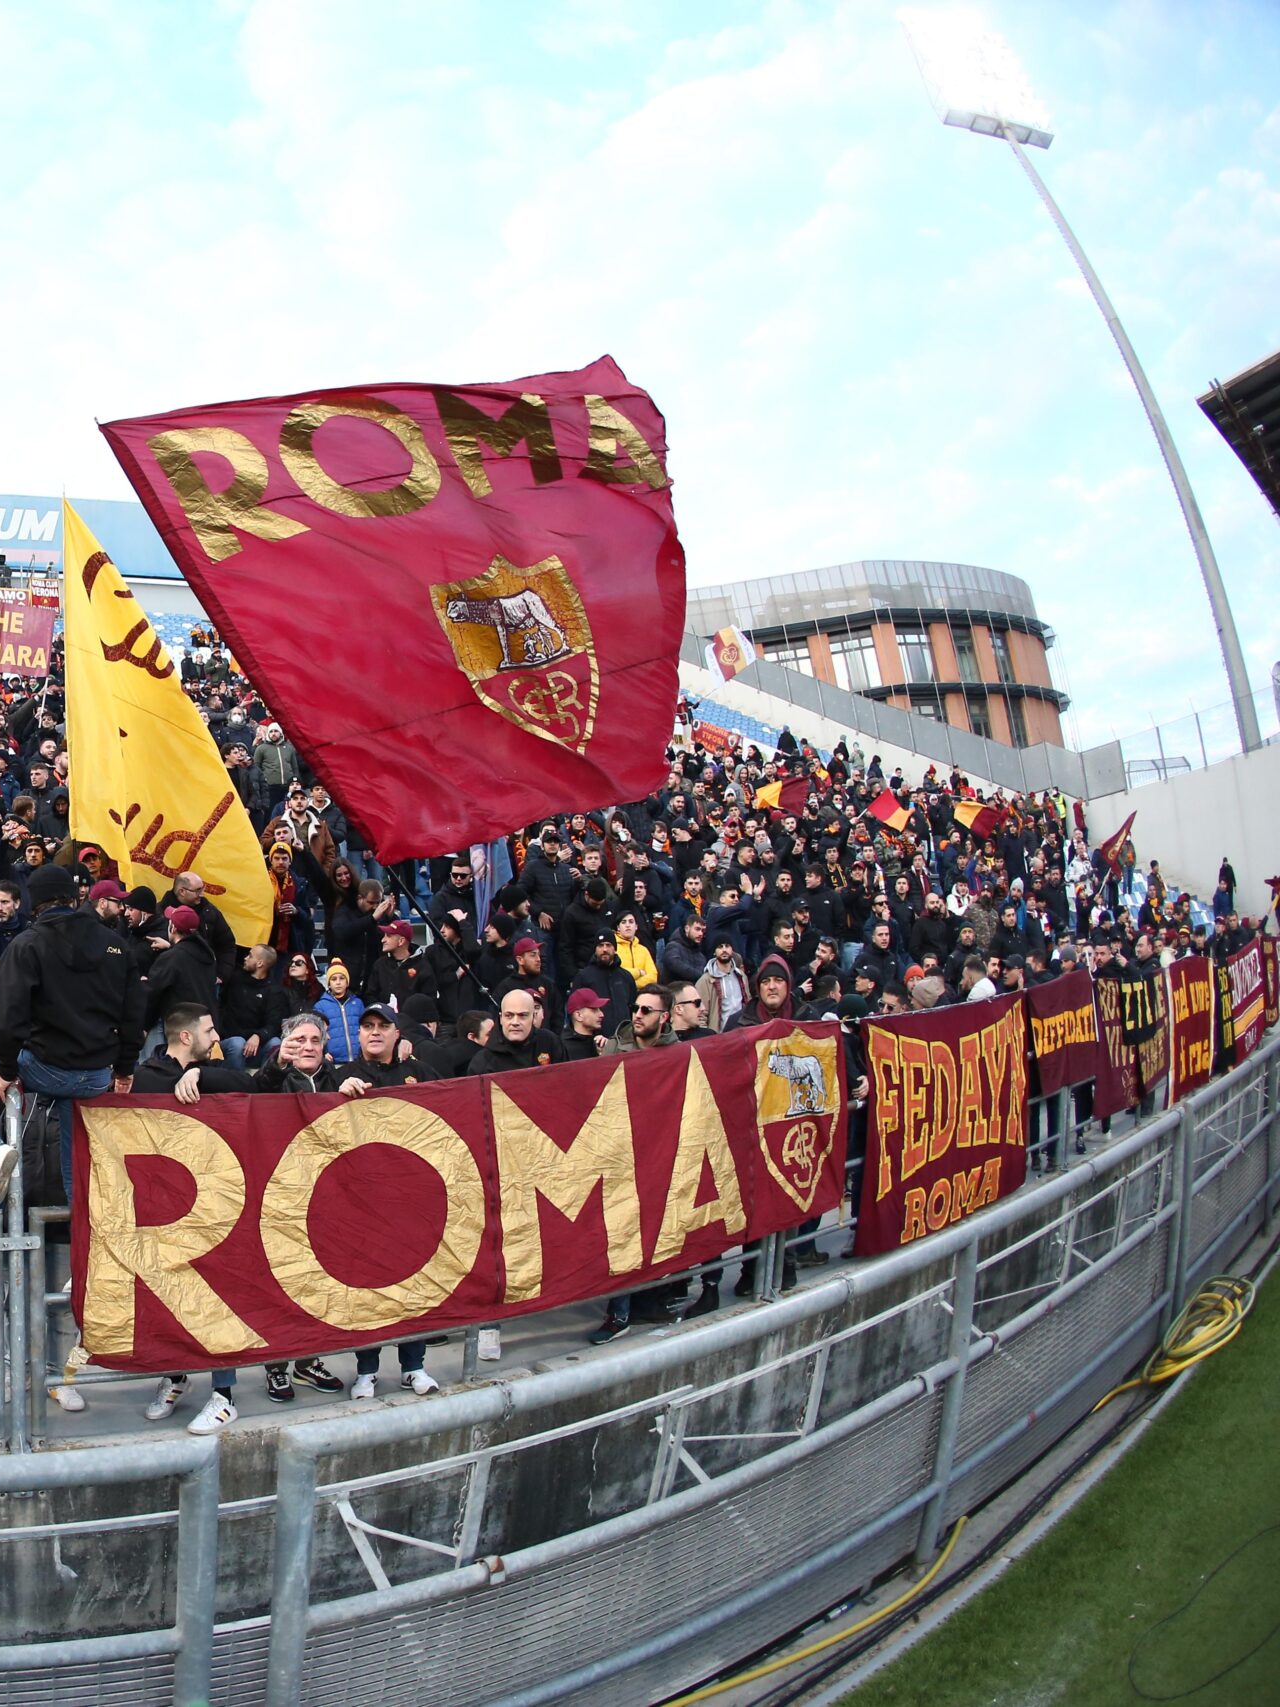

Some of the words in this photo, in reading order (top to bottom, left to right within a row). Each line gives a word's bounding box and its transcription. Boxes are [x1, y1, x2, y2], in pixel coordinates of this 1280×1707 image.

[145, 392, 667, 564] ROMA
[31, 586, 59, 598] VERONA
[867, 999, 1027, 1202] FEDAYN
[80, 1045, 749, 1356] ROMA
[900, 1156, 1001, 1245] ROMA
